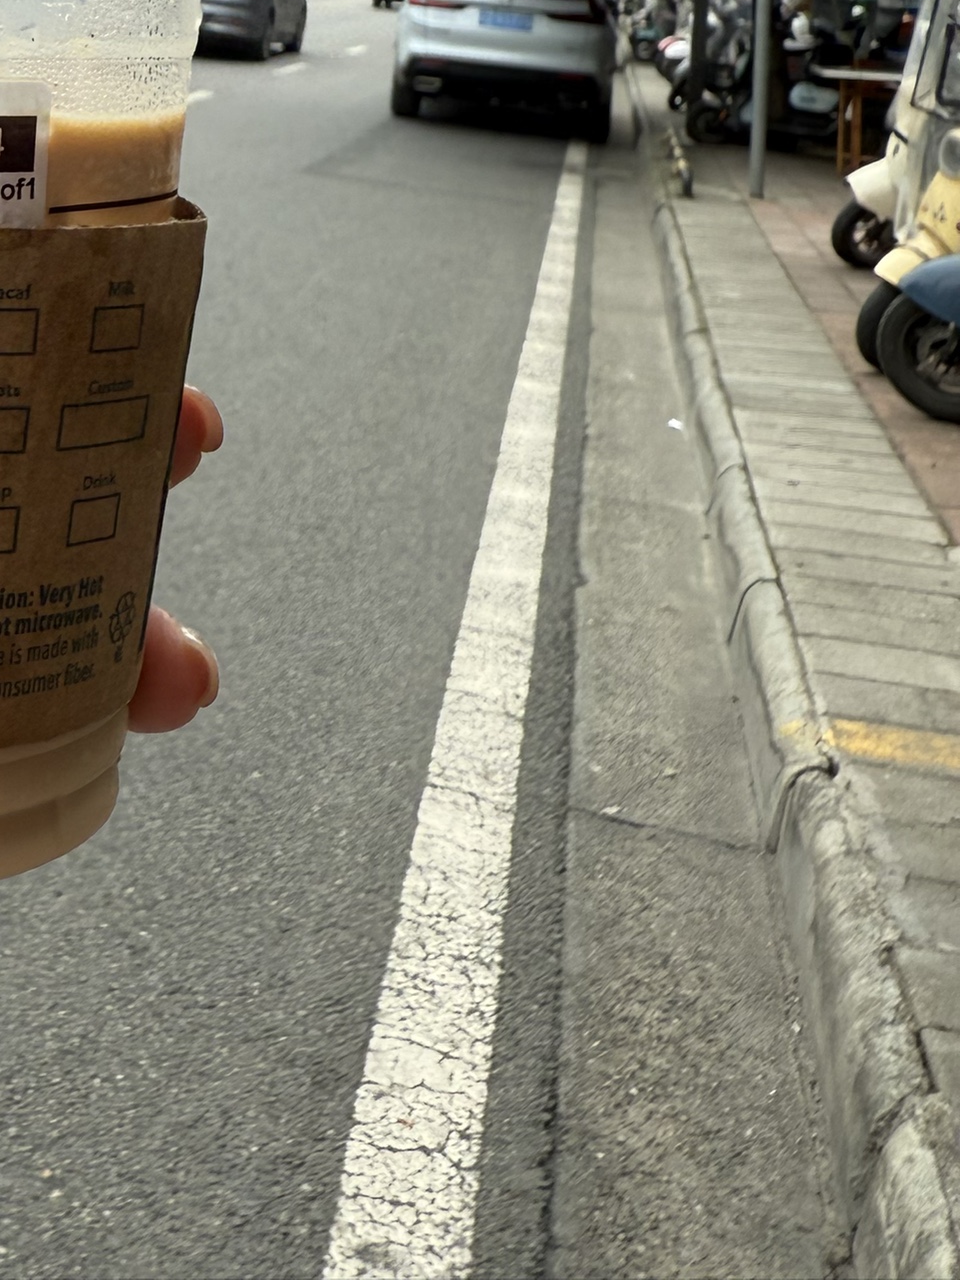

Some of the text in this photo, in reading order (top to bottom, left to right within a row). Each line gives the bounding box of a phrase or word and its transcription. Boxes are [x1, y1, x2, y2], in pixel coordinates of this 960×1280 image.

[39, 584, 75, 608] Very
[78, 576, 104, 599] Hot
[14, 603, 103, 635] microwave.
[9, 643, 23, 665] is
[26, 635, 69, 662] made
[71, 624, 100, 652] with
